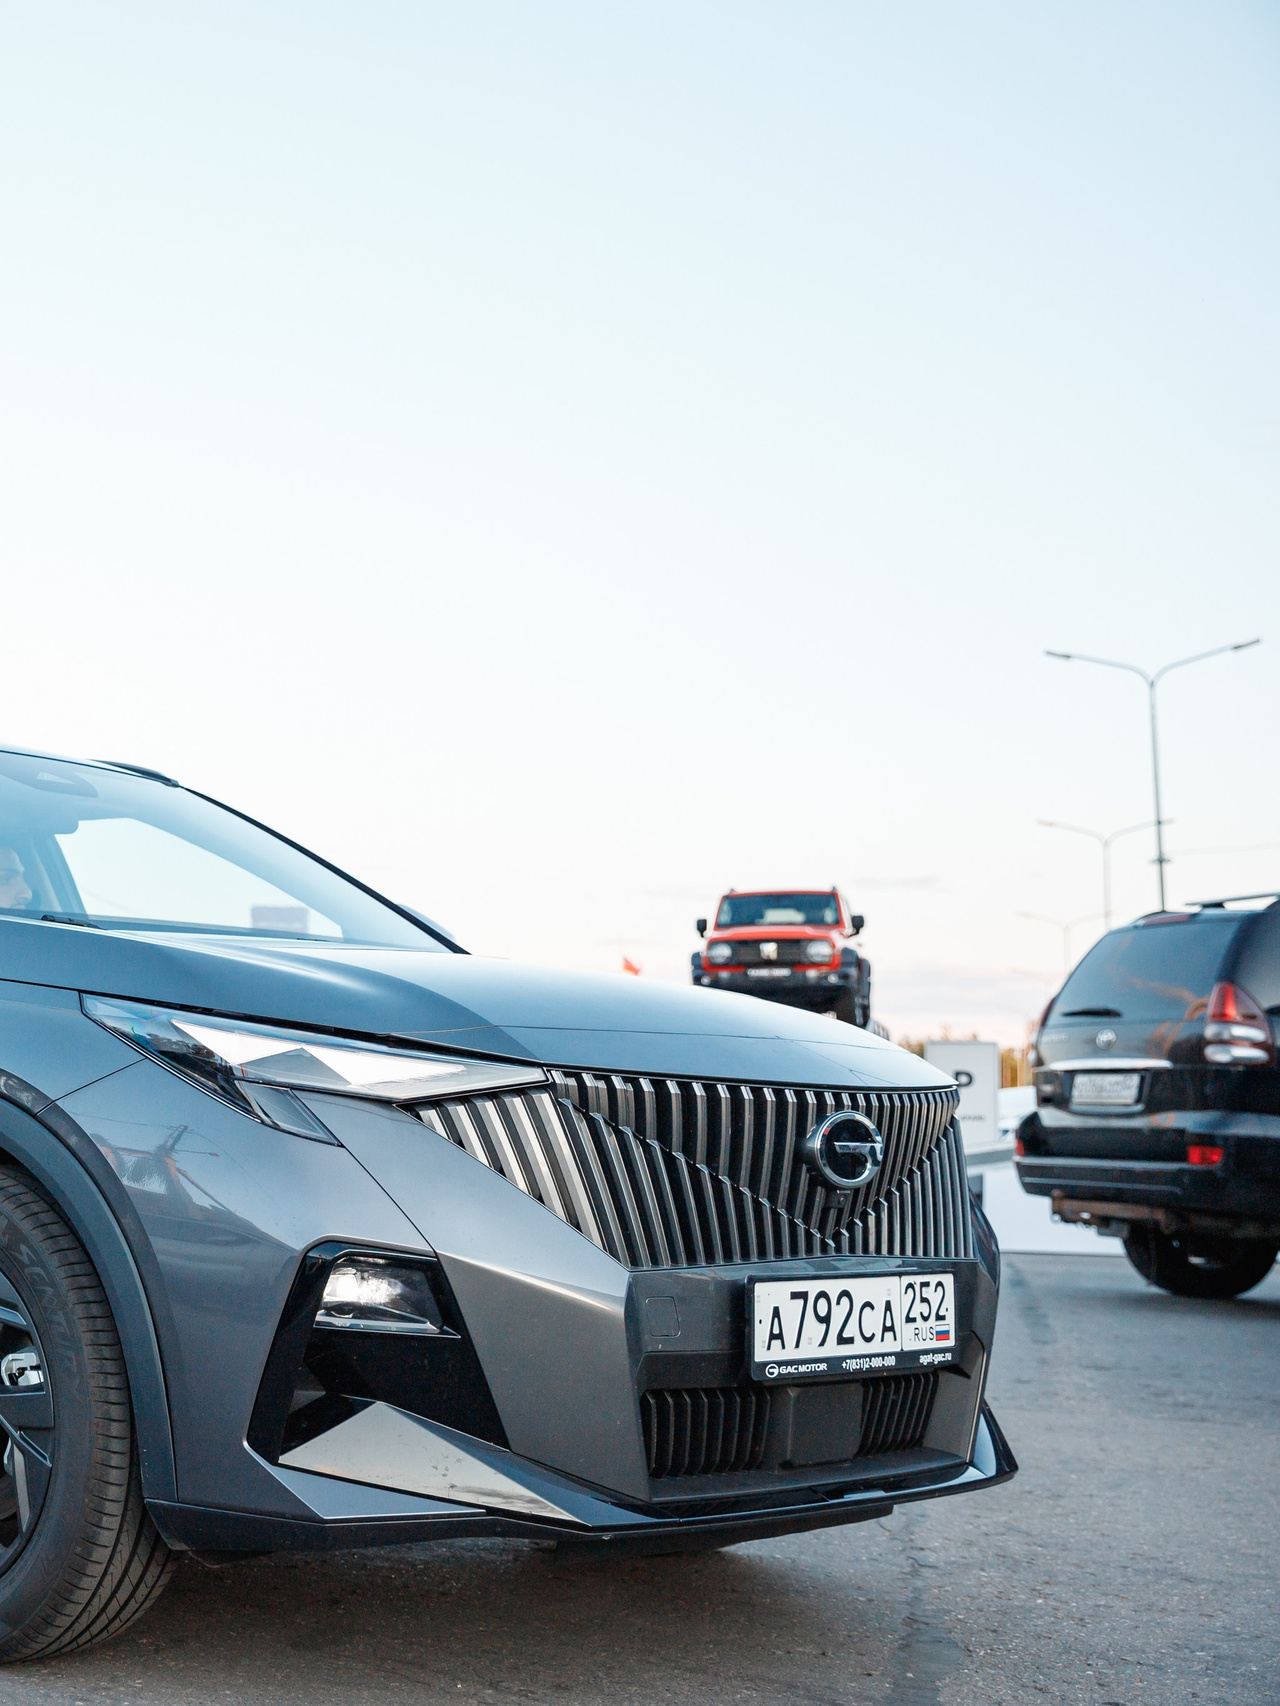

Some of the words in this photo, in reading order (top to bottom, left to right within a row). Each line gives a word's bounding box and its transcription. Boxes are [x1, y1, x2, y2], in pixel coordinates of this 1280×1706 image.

[904, 1280, 947, 1324] 252
[913, 1326, 935, 1342] RUS
[779, 1365, 799, 1374] GAC
[798, 1362, 828, 1373] MOTOR
